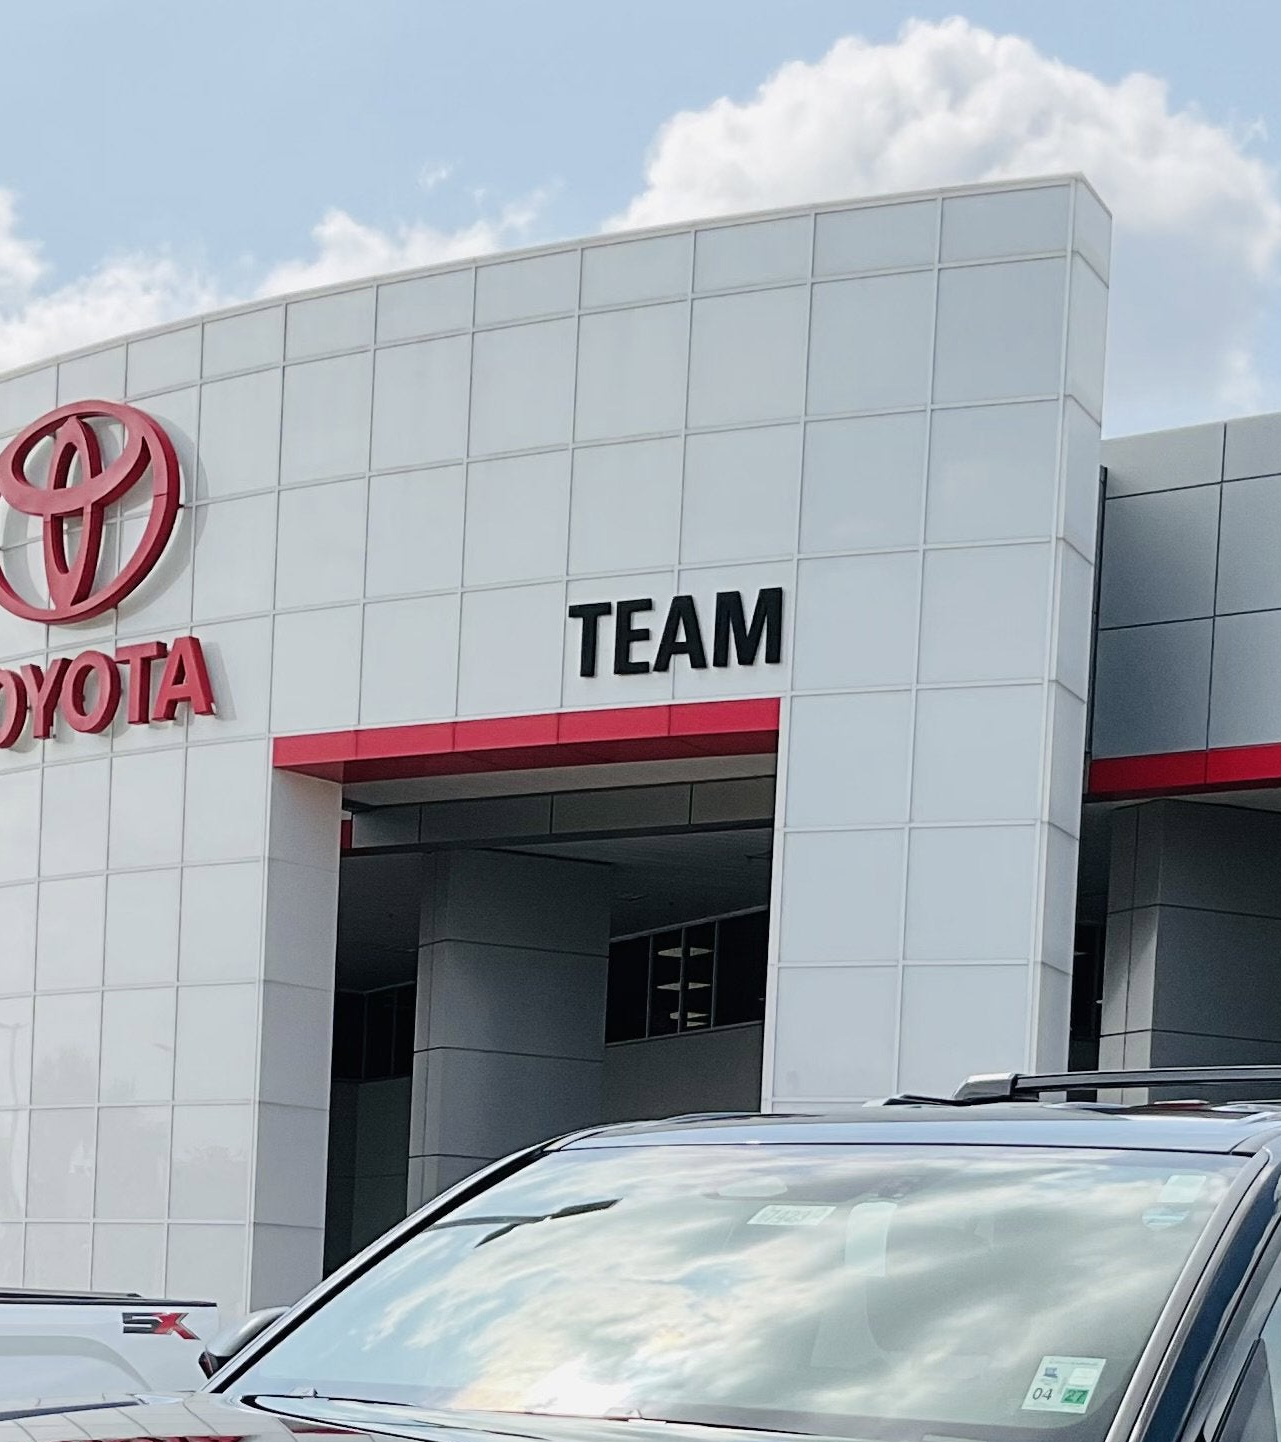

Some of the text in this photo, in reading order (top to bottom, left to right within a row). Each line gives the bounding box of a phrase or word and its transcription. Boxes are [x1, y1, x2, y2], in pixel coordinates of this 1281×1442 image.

[567, 586, 783, 678] TEAM
[1032, 1387, 1089, 1403] 04 27
